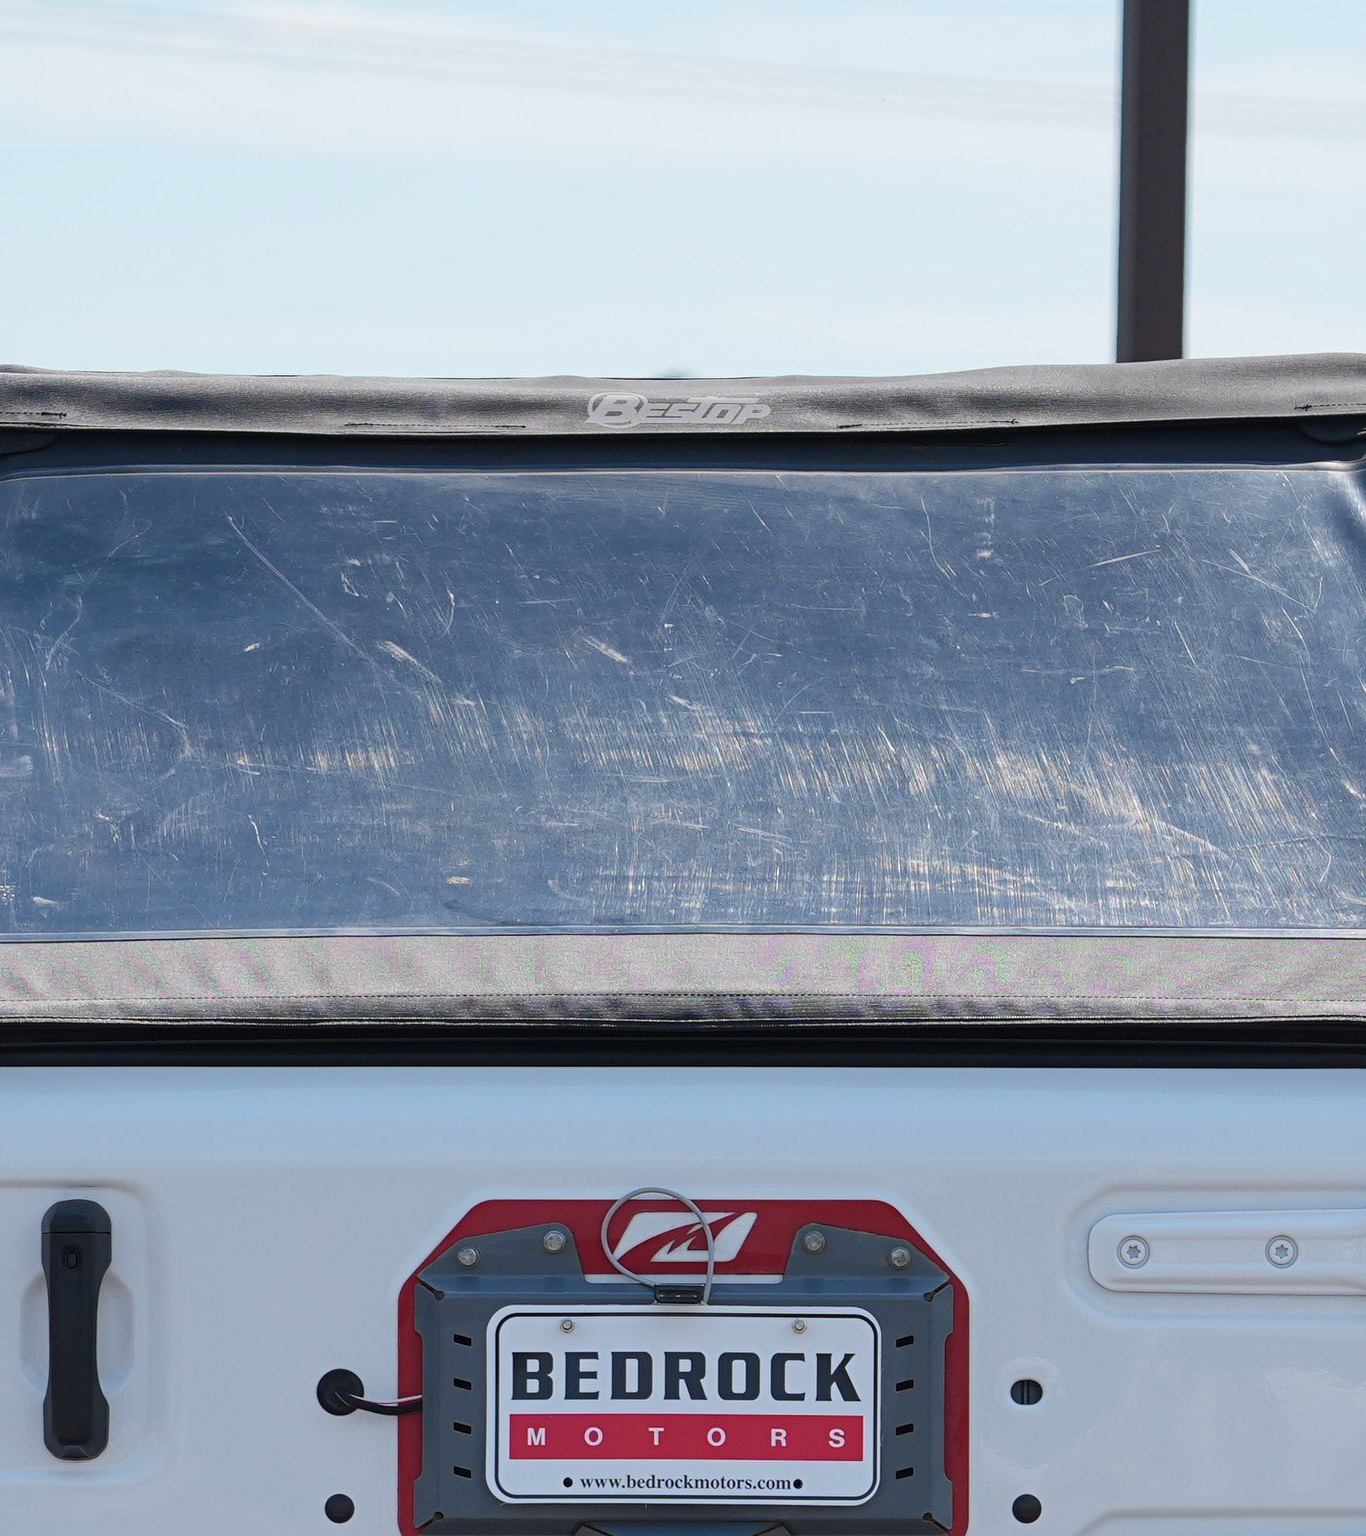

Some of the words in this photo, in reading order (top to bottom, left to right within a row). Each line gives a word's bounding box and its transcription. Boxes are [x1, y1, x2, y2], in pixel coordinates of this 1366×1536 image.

[511, 1351, 862, 1402] BEDROCK
[526, 1427, 847, 1449] MOTORS
[579, 1474, 792, 1491] www.bedrockmotors.com
